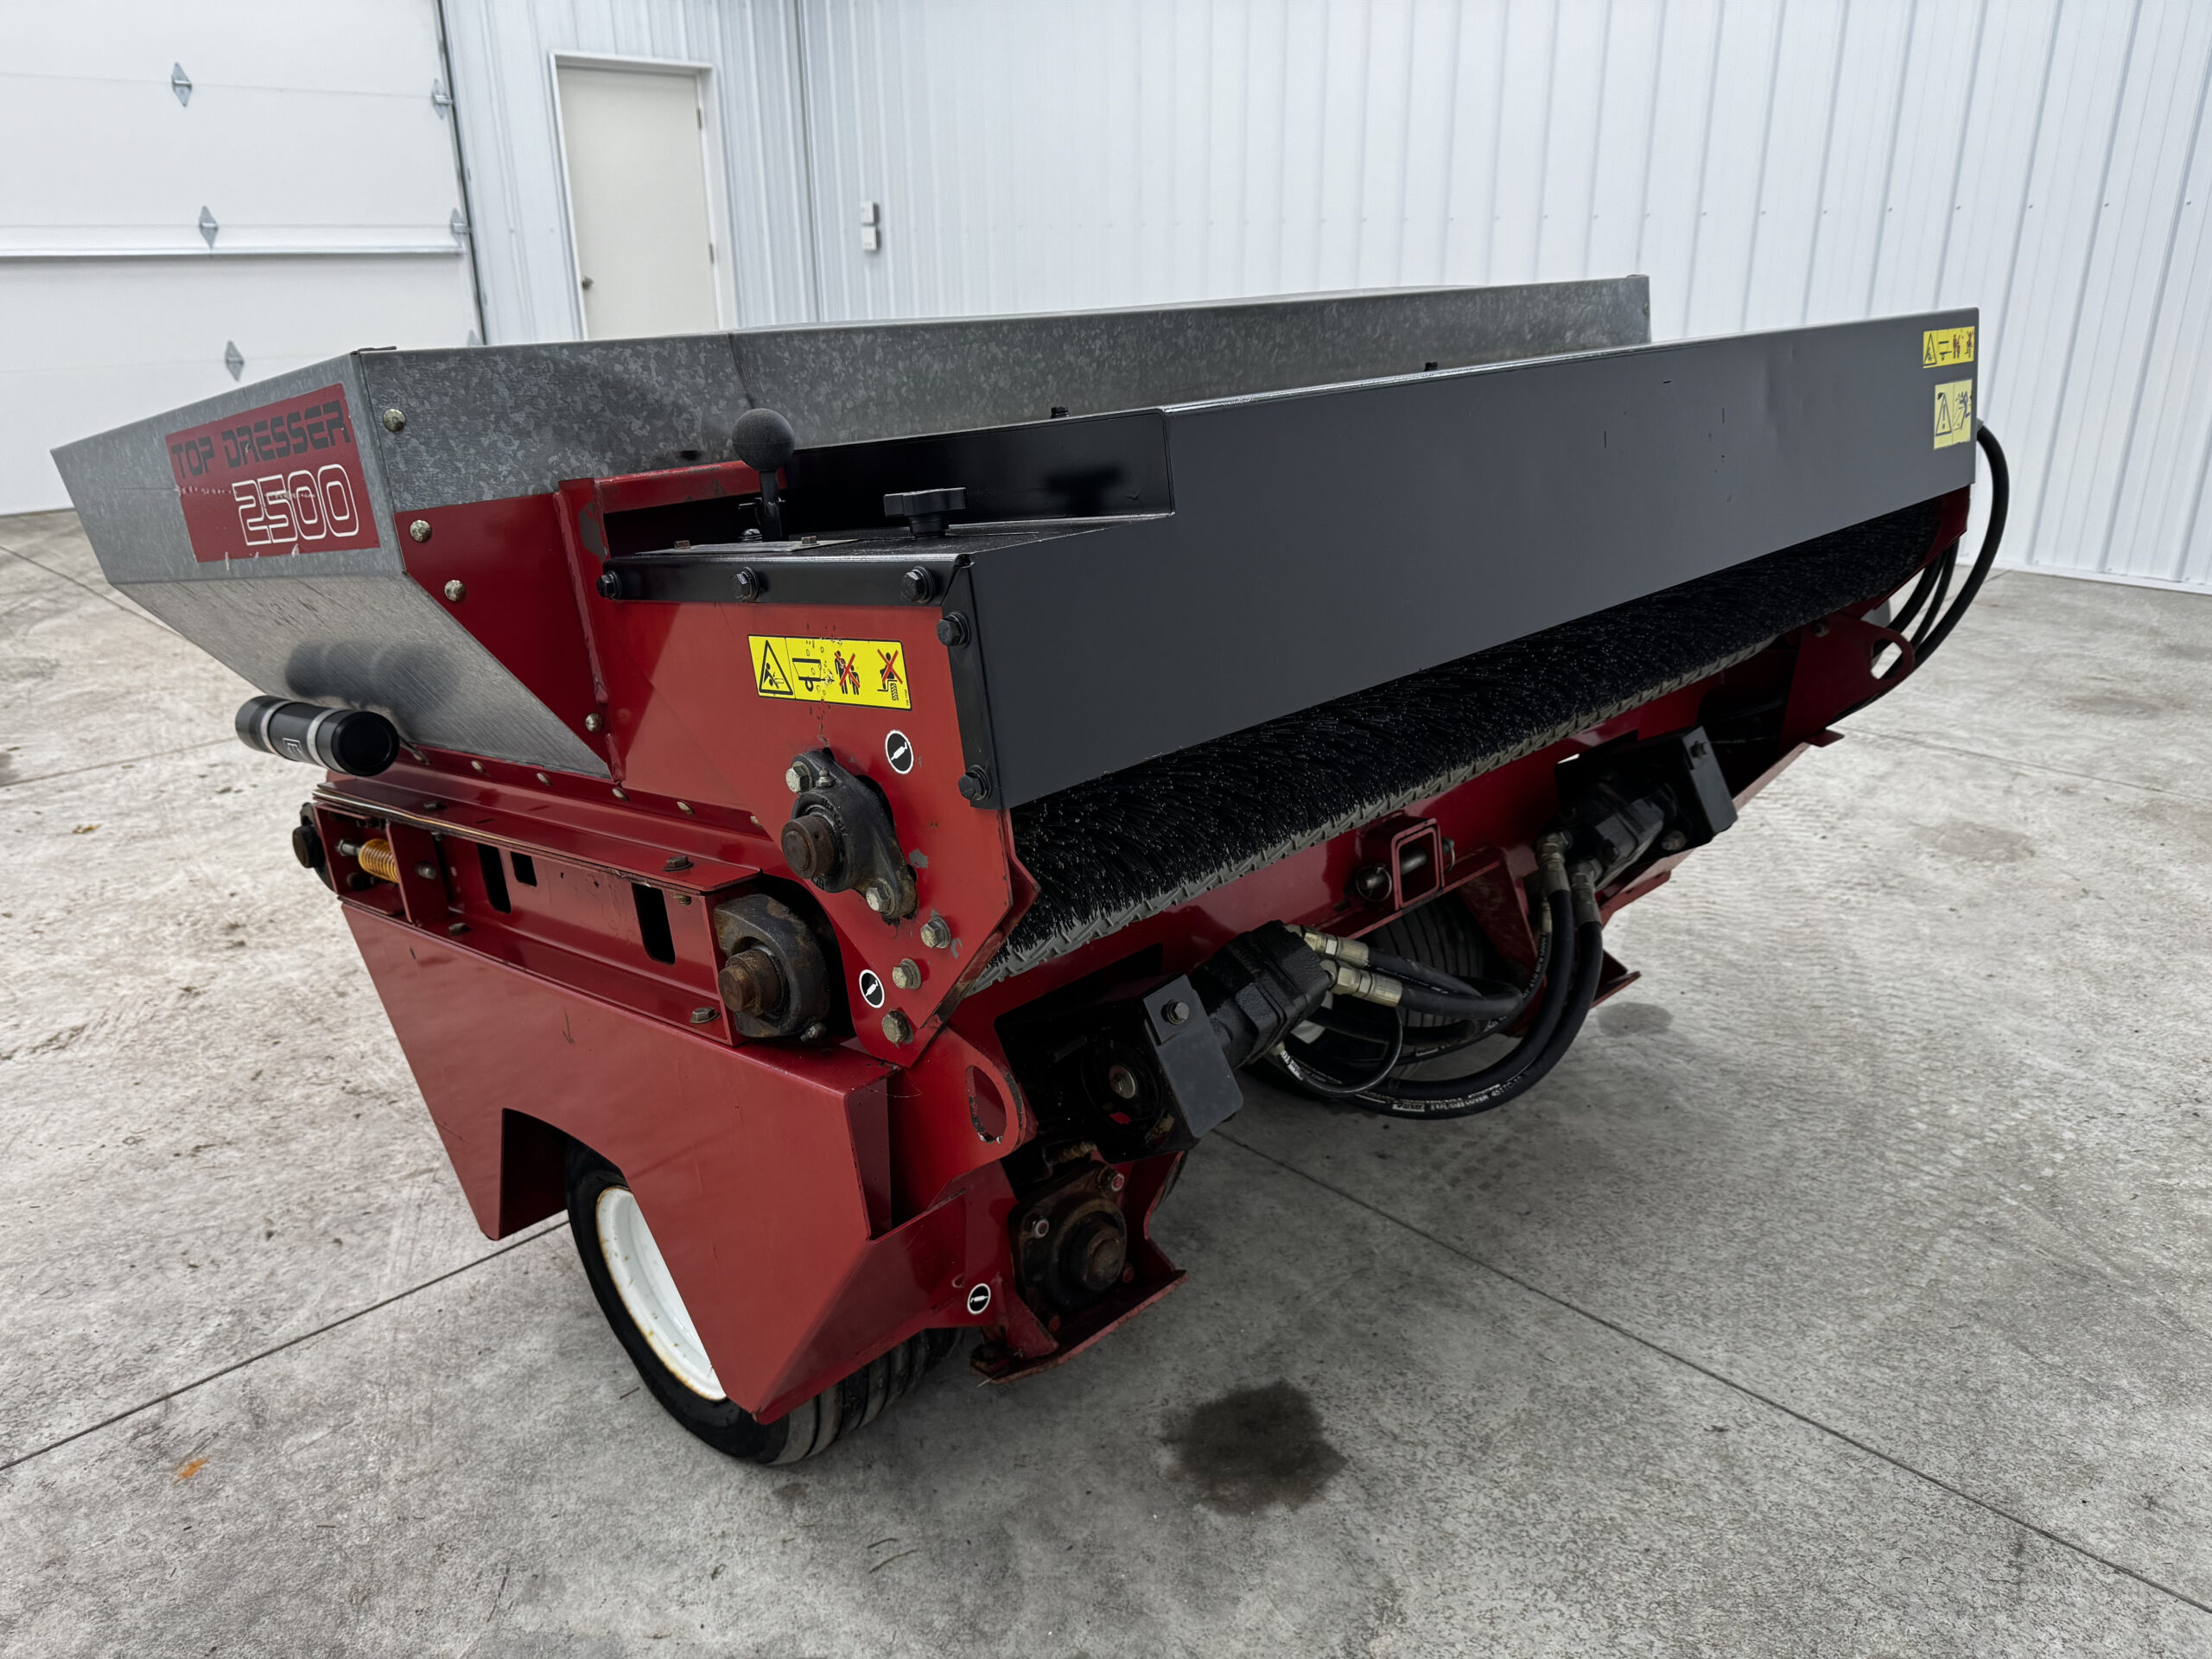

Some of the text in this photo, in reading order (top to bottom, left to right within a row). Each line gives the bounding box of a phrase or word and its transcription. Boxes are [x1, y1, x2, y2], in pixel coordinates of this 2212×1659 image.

[172, 400, 351, 479] TOP DRESSER
[232, 463, 359, 546] 2500
